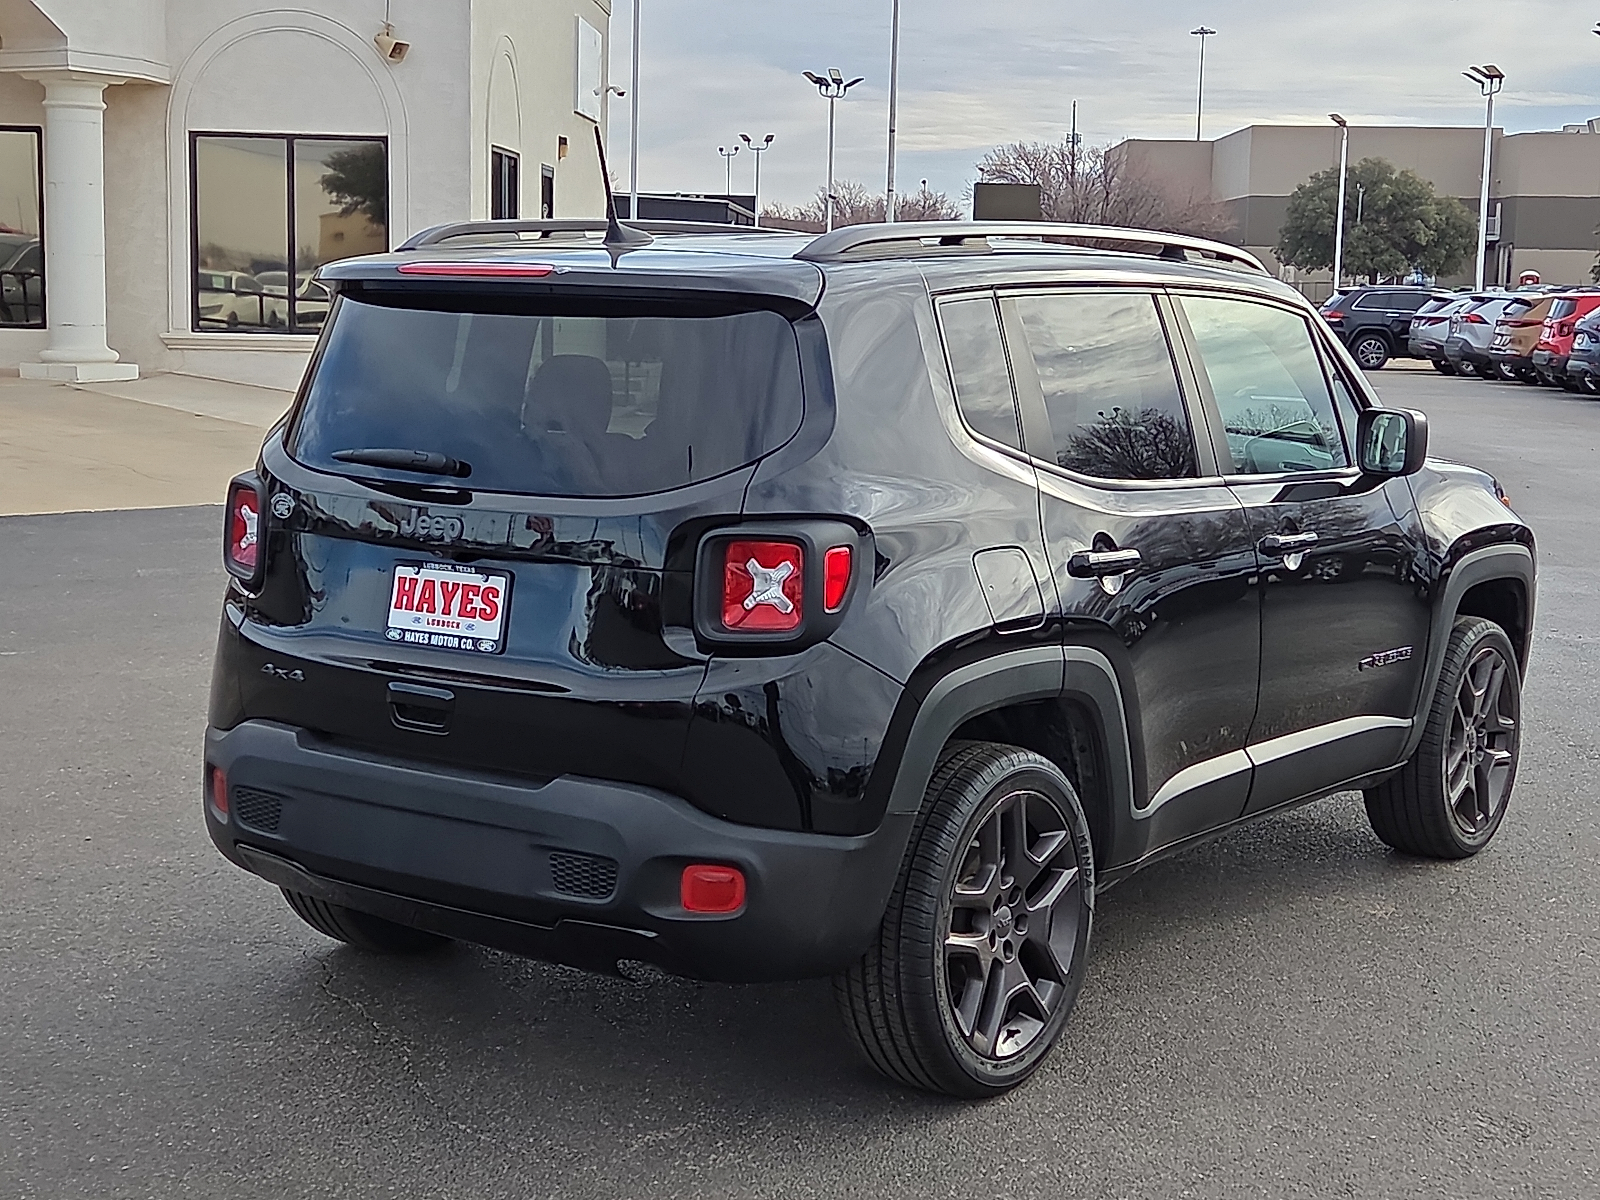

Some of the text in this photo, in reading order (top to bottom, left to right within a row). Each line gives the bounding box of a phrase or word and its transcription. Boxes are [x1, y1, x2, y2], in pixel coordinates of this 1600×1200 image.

[401, 508, 462, 542] Jeep
[394, 576, 500, 622] HAYES
[426, 618, 461, 630] LUBBOCK
[404, 630, 429, 644] HAYES
[430, 635, 459, 648] MOTOR
[460, 640, 475, 650] CO.
